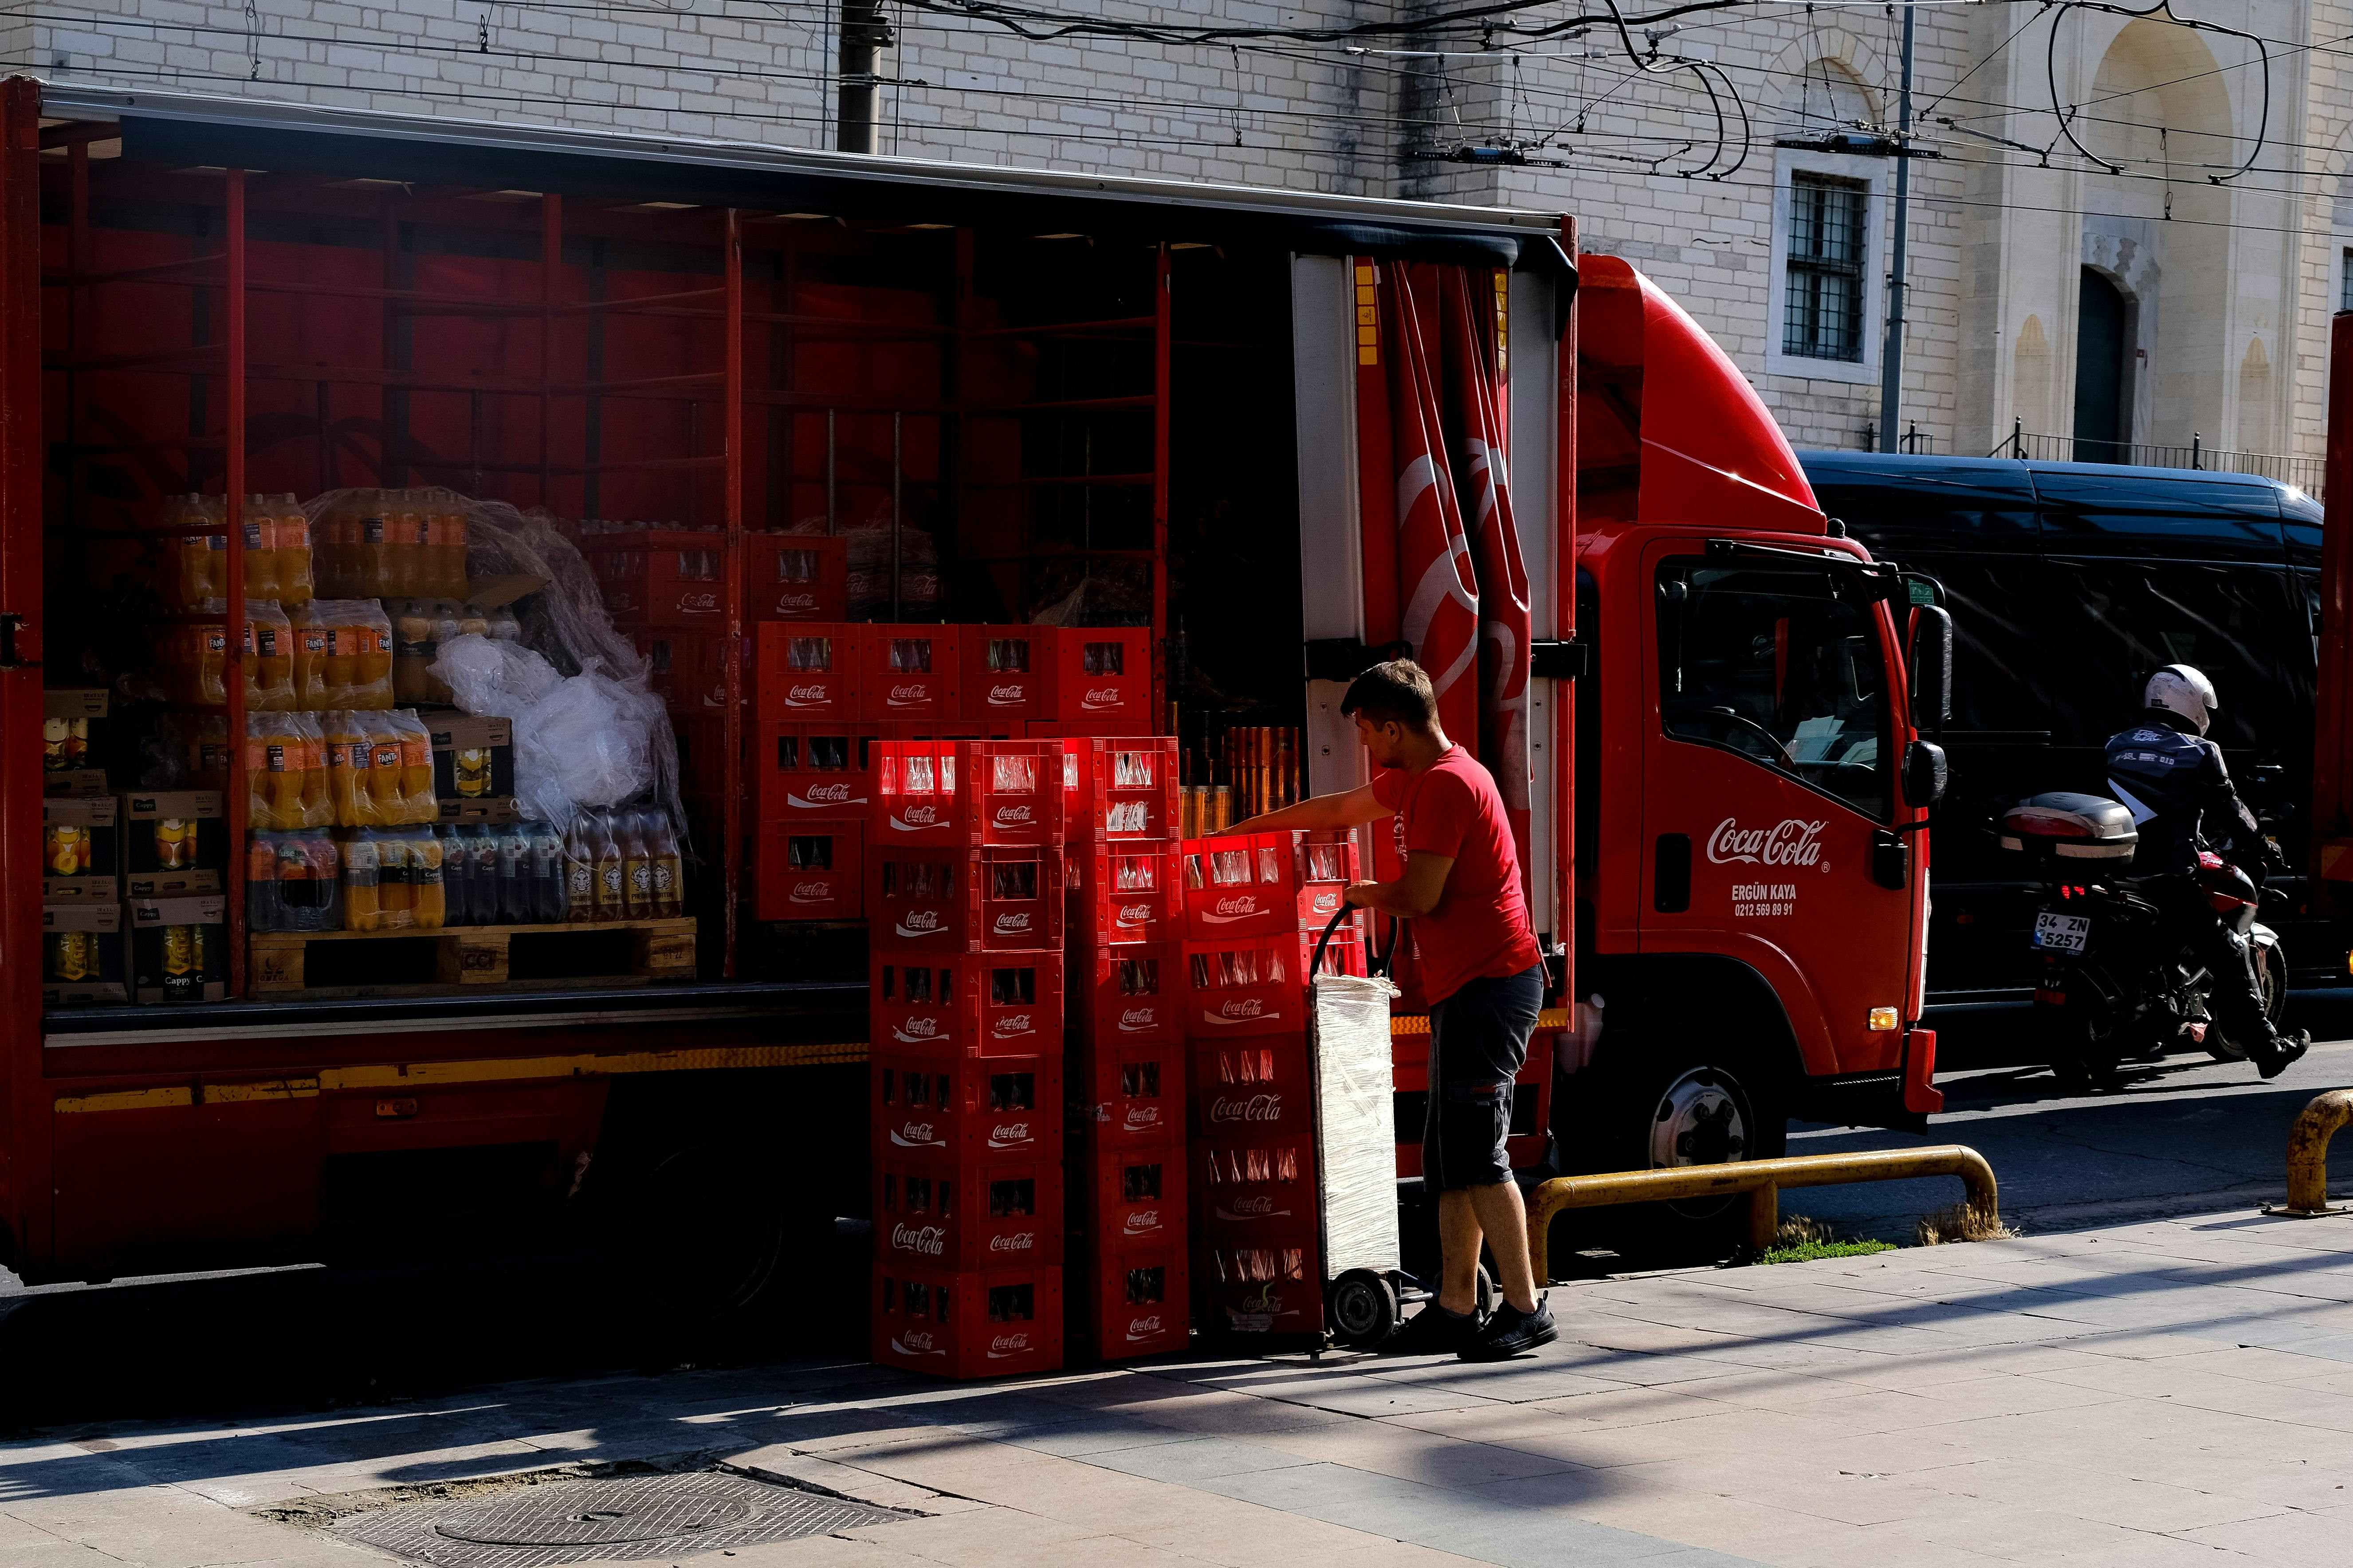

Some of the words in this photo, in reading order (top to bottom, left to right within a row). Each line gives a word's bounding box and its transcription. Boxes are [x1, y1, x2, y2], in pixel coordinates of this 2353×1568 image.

[790, 685, 826, 699] Coca-Cola
[892, 685, 927, 698] Coca-Cola
[991, 685, 1023, 698] Coca-Cola
[1086, 688, 1119, 702] Coca-Cola
[807, 784, 851, 800] Coca-Cola
[904, 806, 936, 823] Coca-Cola
[997, 806, 1031, 820] Coca-Cola
[1707, 818, 1829, 866] Coca-Cola
[793, 882, 830, 895] Coca-Cola
[1732, 882, 1767, 901] ERGÜN
[1770, 885, 1796, 899] KAYA
[1217, 895, 1257, 914] Coca-Cola
[1315, 893, 1337, 907] Coca-Cola
[1120, 905, 1151, 919] Coca-Cola
[1735, 904, 1754, 917] 0212
[1756, 904, 1770, 916] 569
[1772, 904, 1782, 916] 89
[1783, 903, 1793, 915] 91
[907, 910, 938, 928] Coca-Cola
[997, 913, 1031, 926] Coca-Cola
[2039, 915, 2057, 928] 34
[2067, 918, 2087, 932] ZN
[2045, 933, 2083, 948] 5257
[165, 976, 191, 986] Cappy
[1122, 1008, 1154, 1023] Coca-Cola
[1222, 999, 1263, 1016] Coca-Cola
[906, 1016, 937, 1035] Coca-Cola
[1127, 1107, 1159, 1122] Coca-Cola
[1211, 1094, 1281, 1122] Coca-Cola
[904, 1121, 934, 1141] Coca-Cola
[993, 1123, 1029, 1139] Coca-Cola
[1127, 1210, 1159, 1226] Coca-Cola
[892, 1223, 945, 1255] Coca-Cola
[990, 1232, 1035, 1251] Coca-Cola
[1130, 1315, 1160, 1332] Coca-Cola
[992, 1333, 1029, 1350] Coca-Cola
